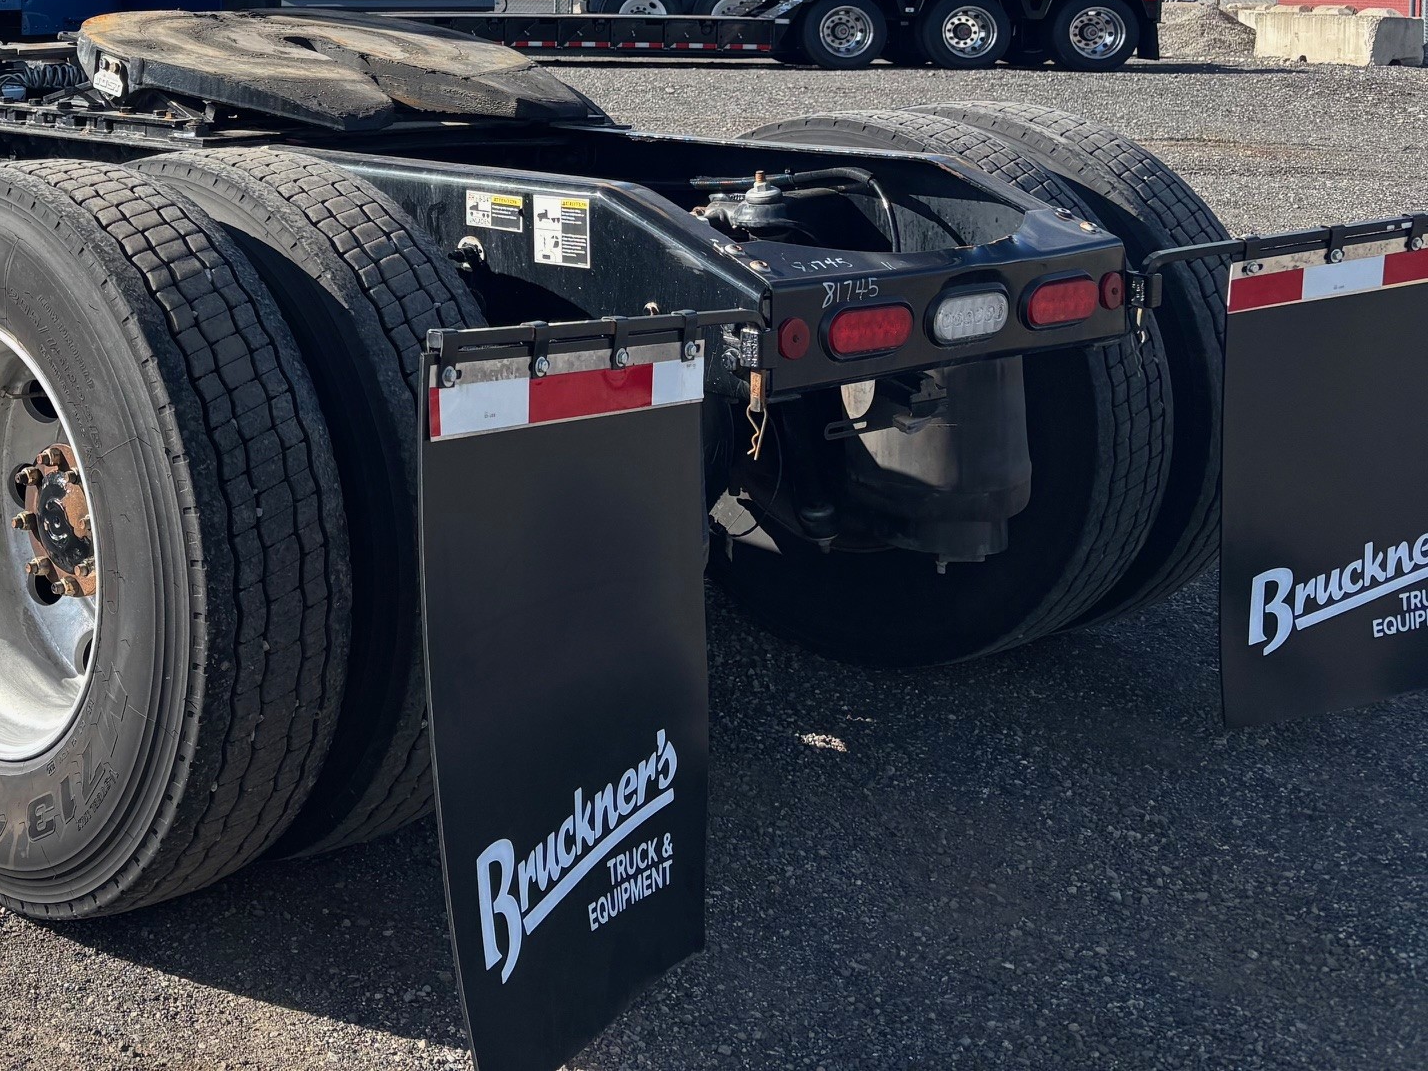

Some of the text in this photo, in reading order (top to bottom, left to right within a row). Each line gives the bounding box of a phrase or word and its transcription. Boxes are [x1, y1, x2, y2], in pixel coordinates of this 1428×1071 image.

[821, 277, 880, 309] 81745
[1372, 609, 1428, 638] EQUIP
[476, 728, 678, 985] Bruckner's
[606, 832, 674, 886] TRUCK &
[587, 859, 674, 932] EQUIPMENT
